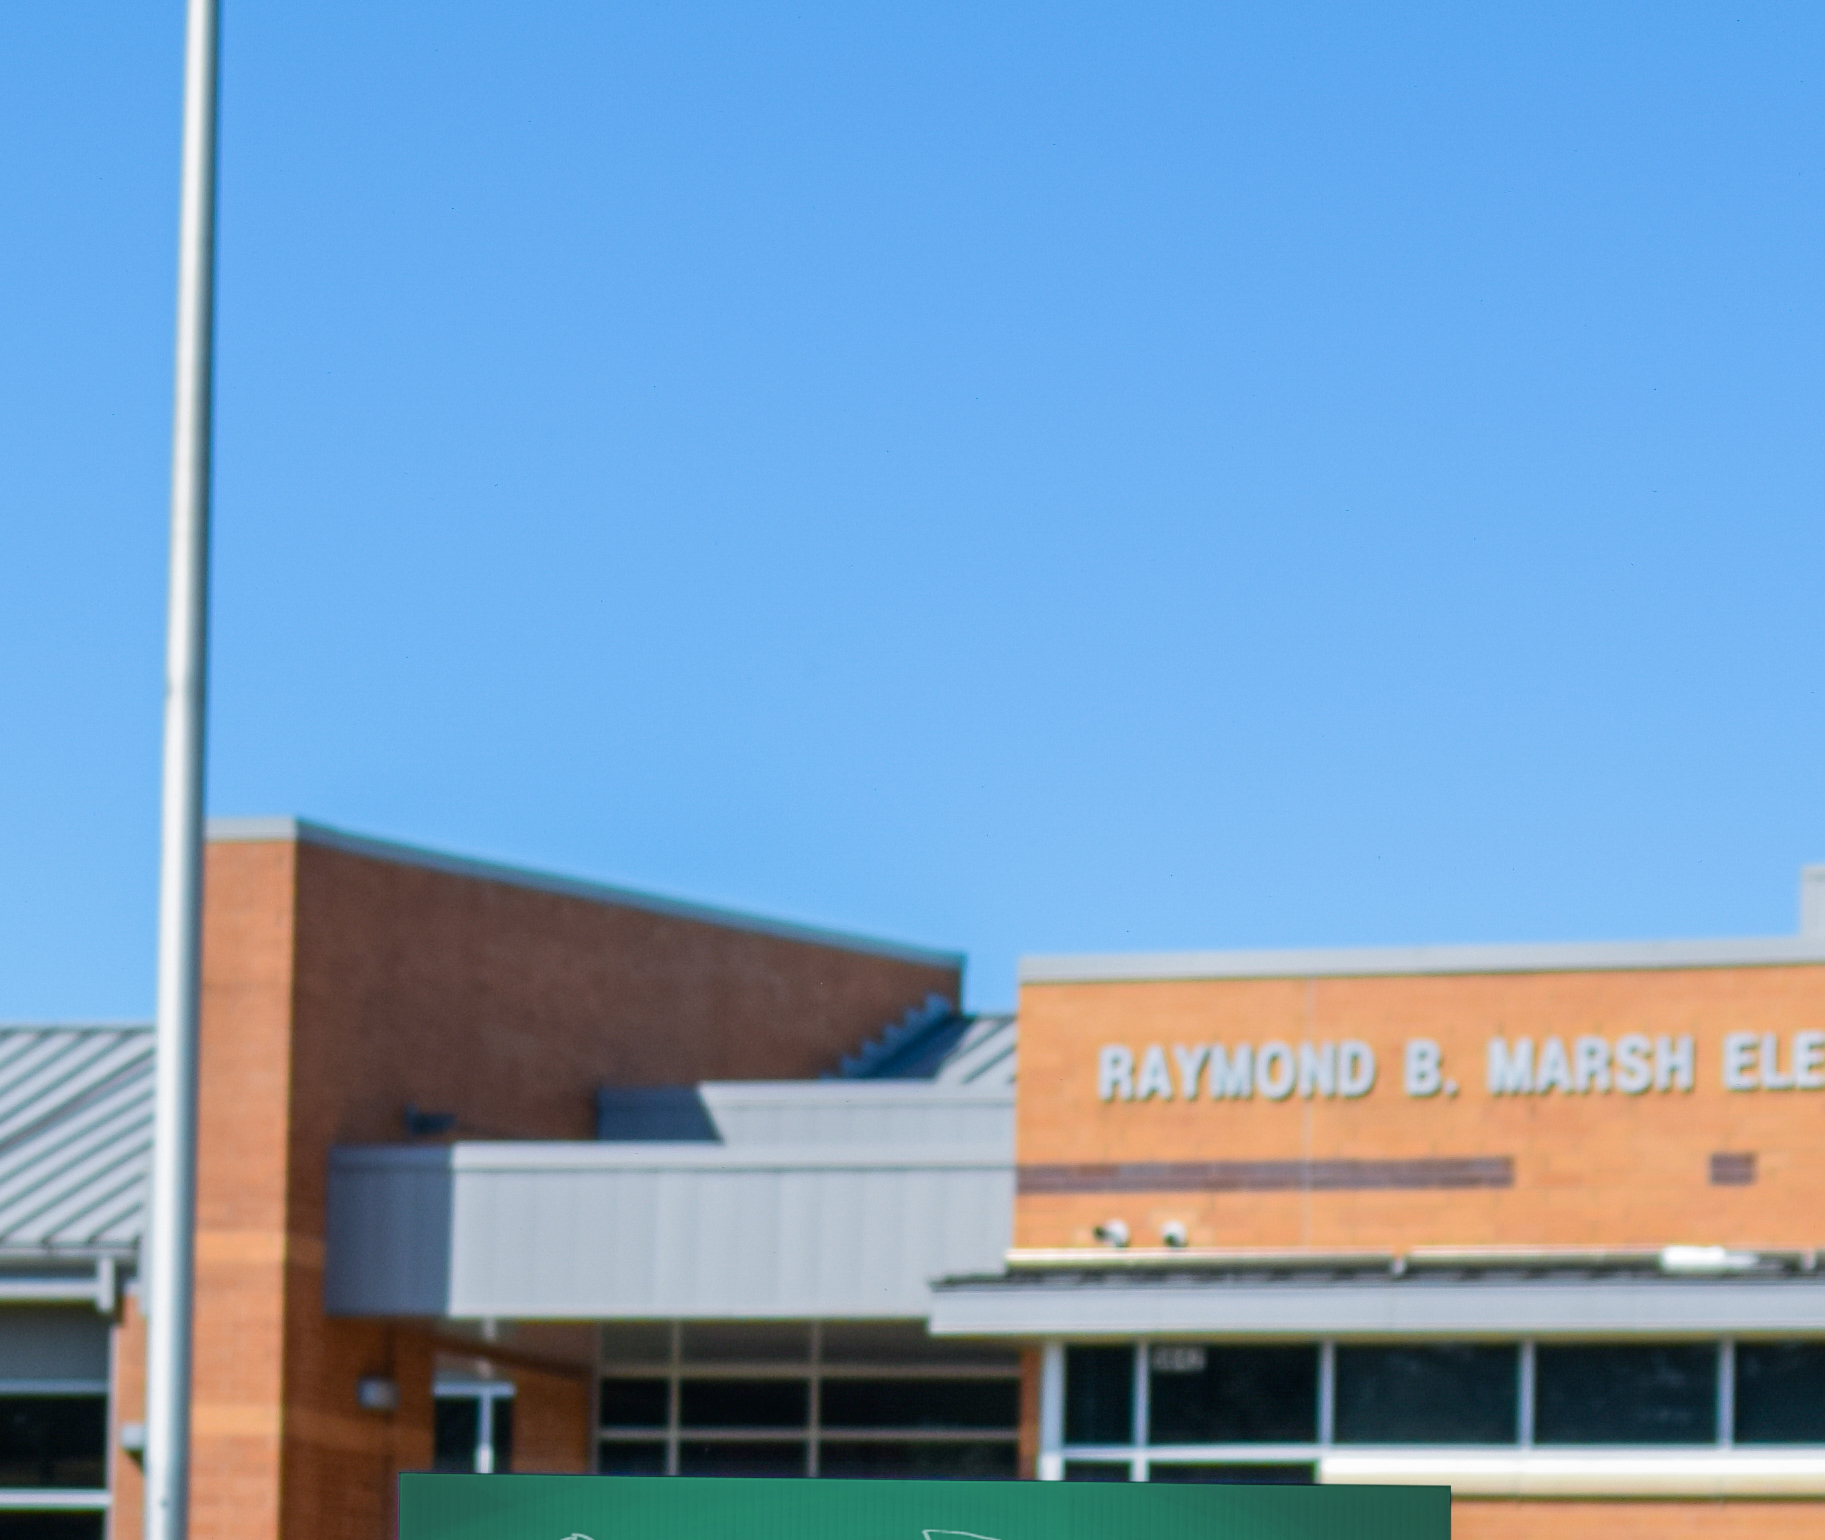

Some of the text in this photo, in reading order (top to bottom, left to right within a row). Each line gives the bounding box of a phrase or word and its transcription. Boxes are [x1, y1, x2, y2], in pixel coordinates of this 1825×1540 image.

[1099, 1040, 1377, 1100] RAYMOND
[1405, 1038, 1459, 1098] B.
[1488, 1033, 1695, 1096] MARSH
